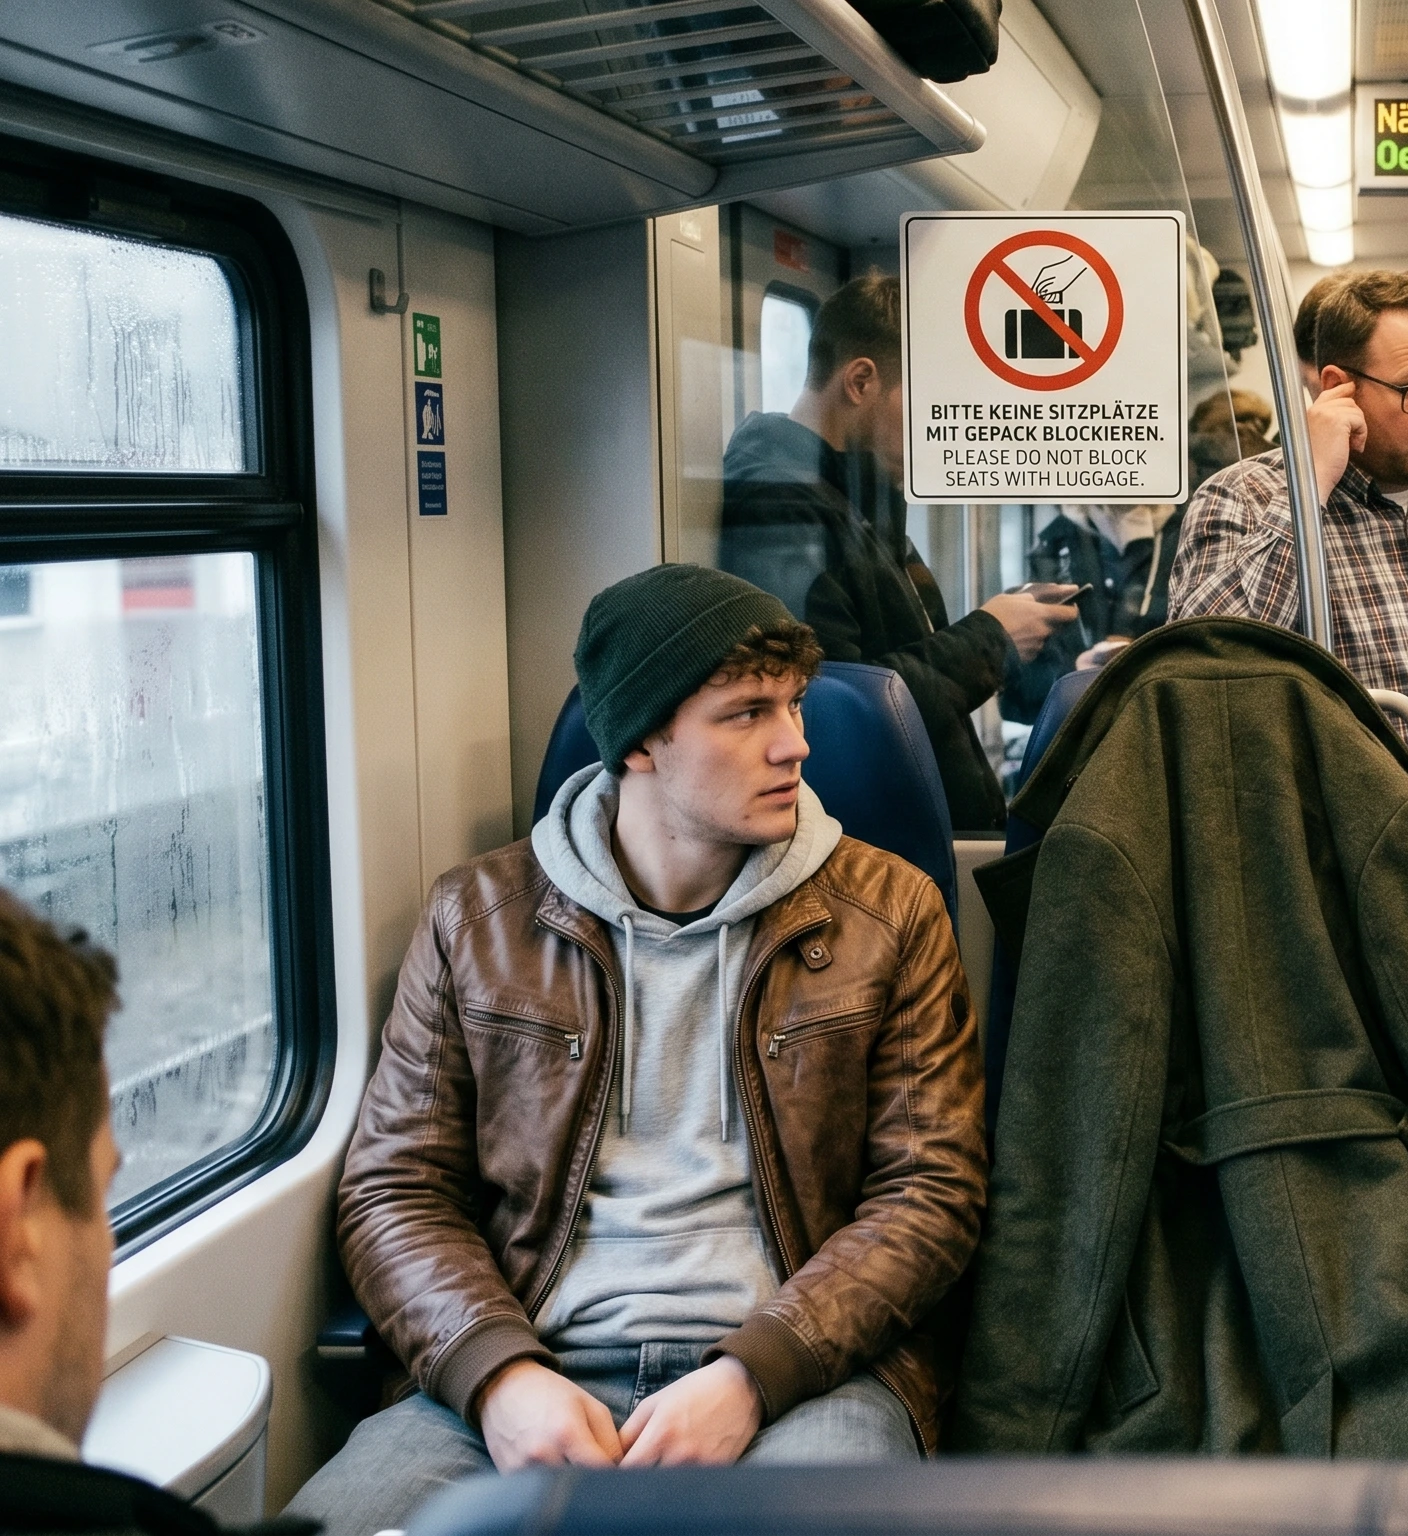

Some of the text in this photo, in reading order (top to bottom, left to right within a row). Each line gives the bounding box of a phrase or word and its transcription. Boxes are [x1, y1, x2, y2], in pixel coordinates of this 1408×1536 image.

[931, 400, 1159, 420] BITTE KEINE SITZPLÄTZE
[926, 425, 1165, 442] MIT GEPACK BLOCKIEREN.
[943, 450, 1147, 465] PLEASE DO NOT BLOCK
[945, 471, 1145, 487] SEATS WITH LUGGAGE.
